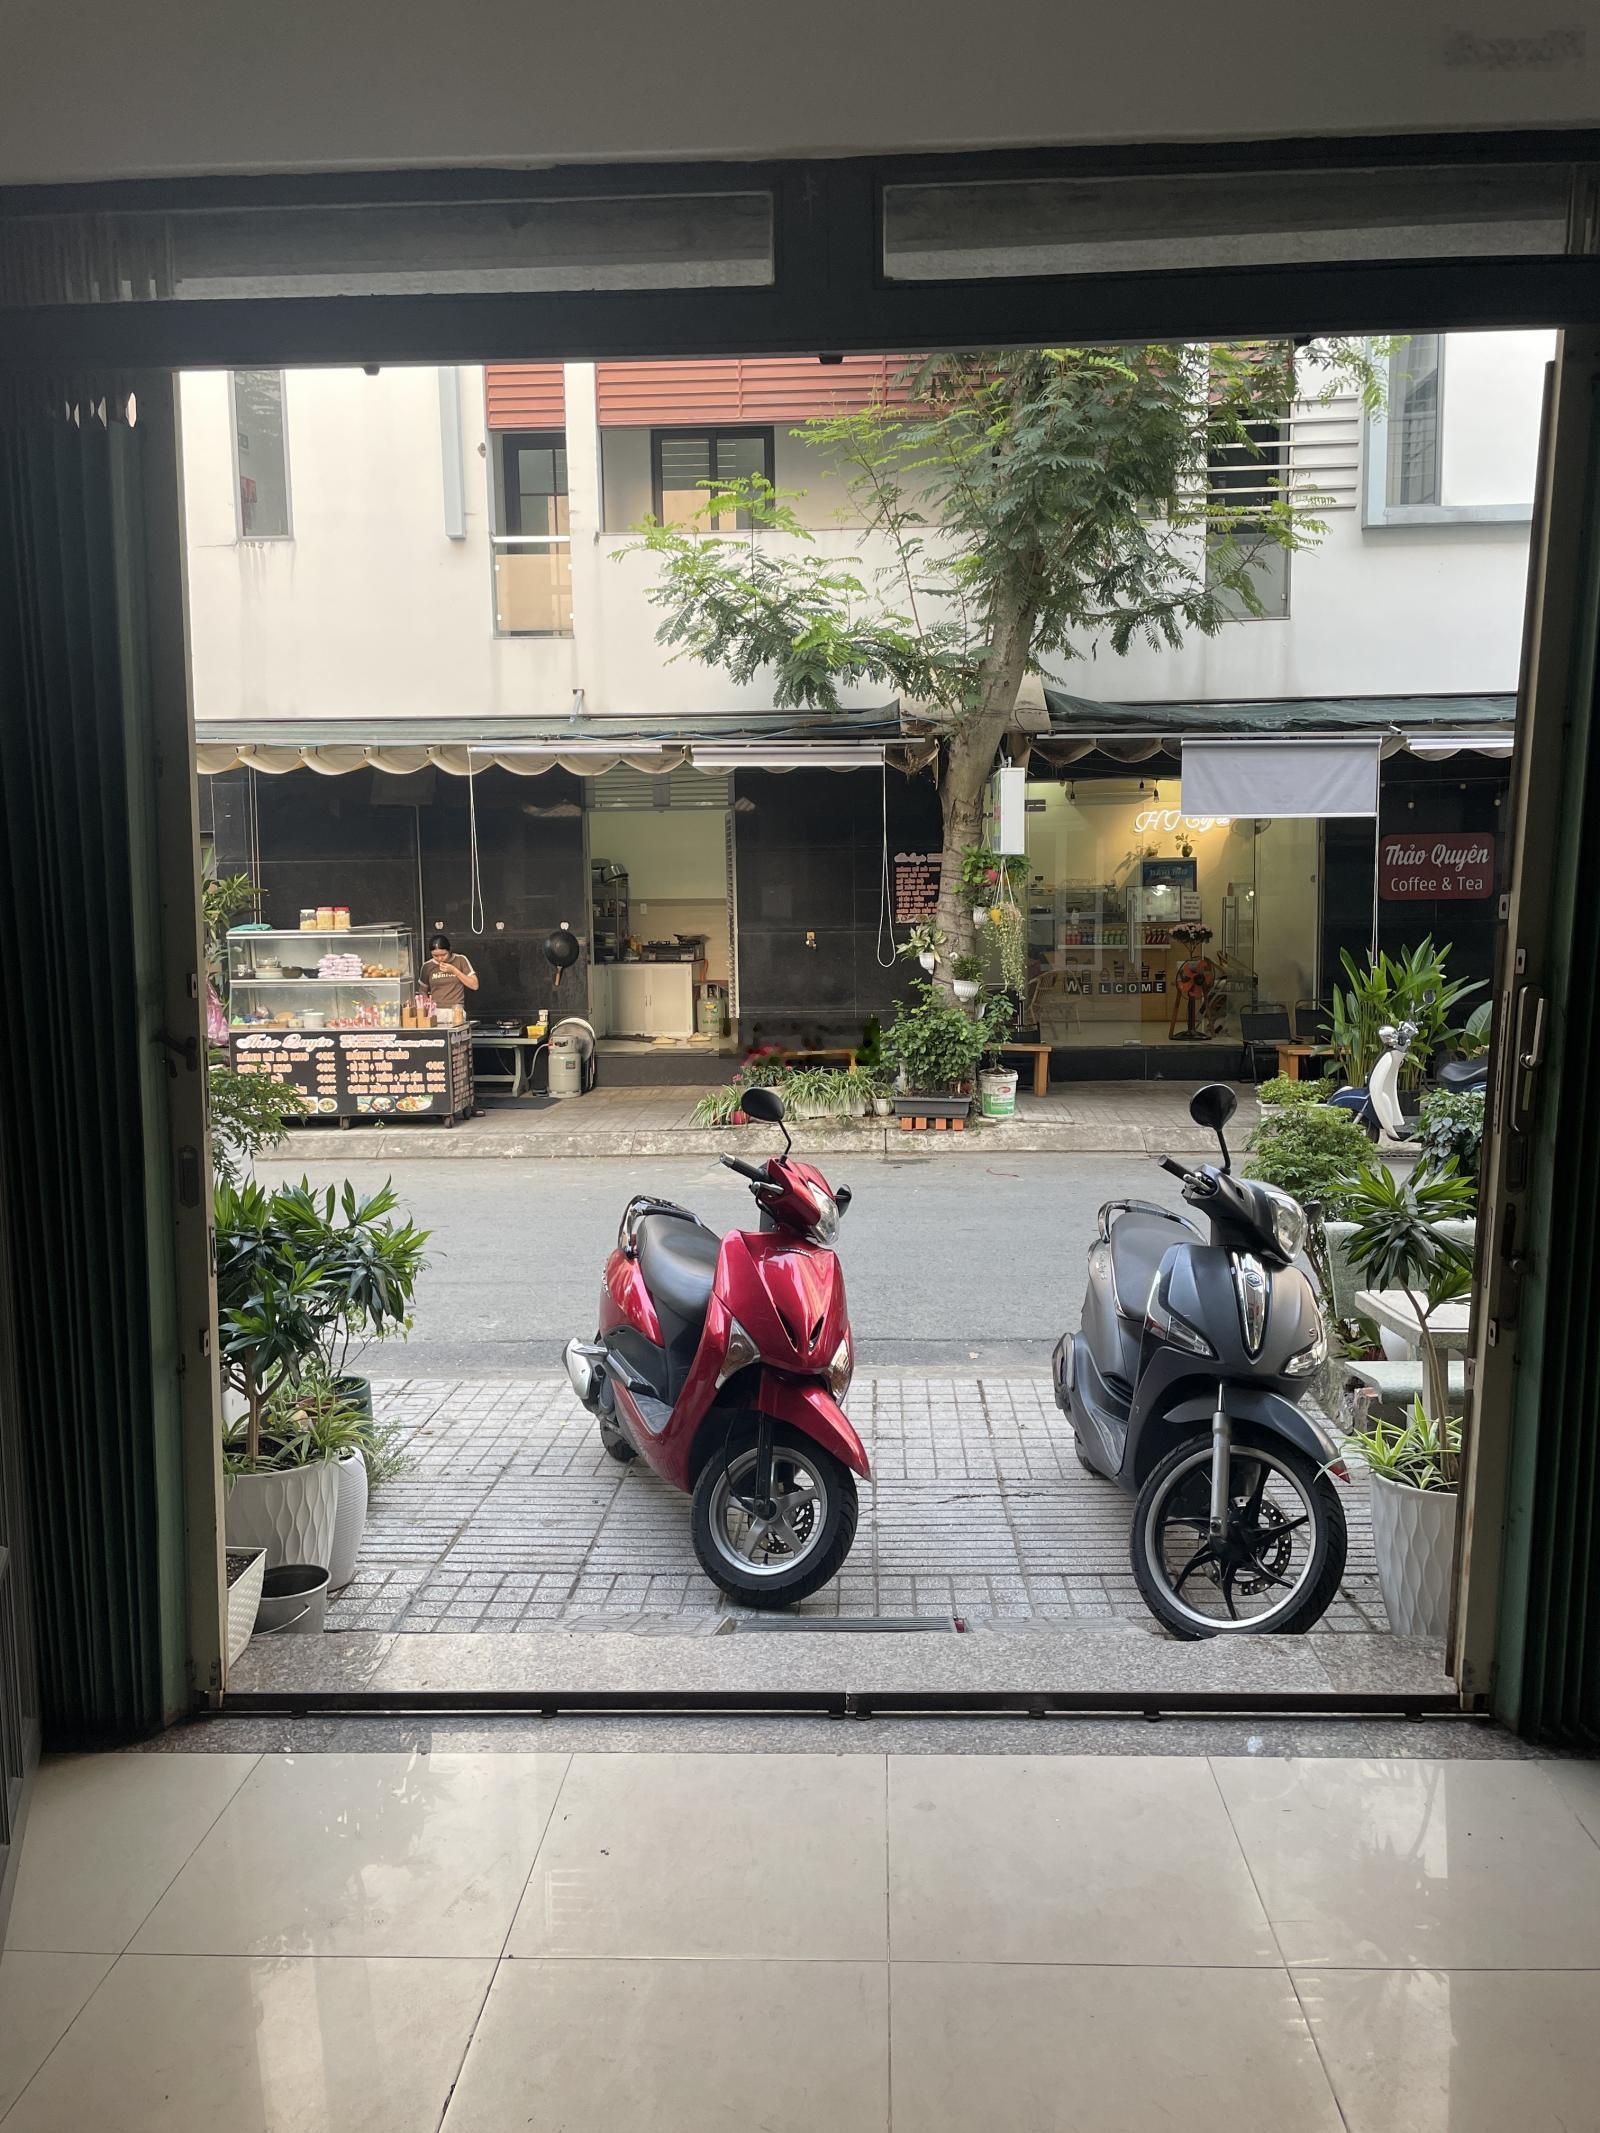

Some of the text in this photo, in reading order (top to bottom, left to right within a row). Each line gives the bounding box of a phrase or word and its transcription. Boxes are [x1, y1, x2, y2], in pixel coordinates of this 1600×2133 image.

[1385, 843, 1489, 872] Thảo Quyên
[1391, 876, 1483, 892] Coffee & Tea
